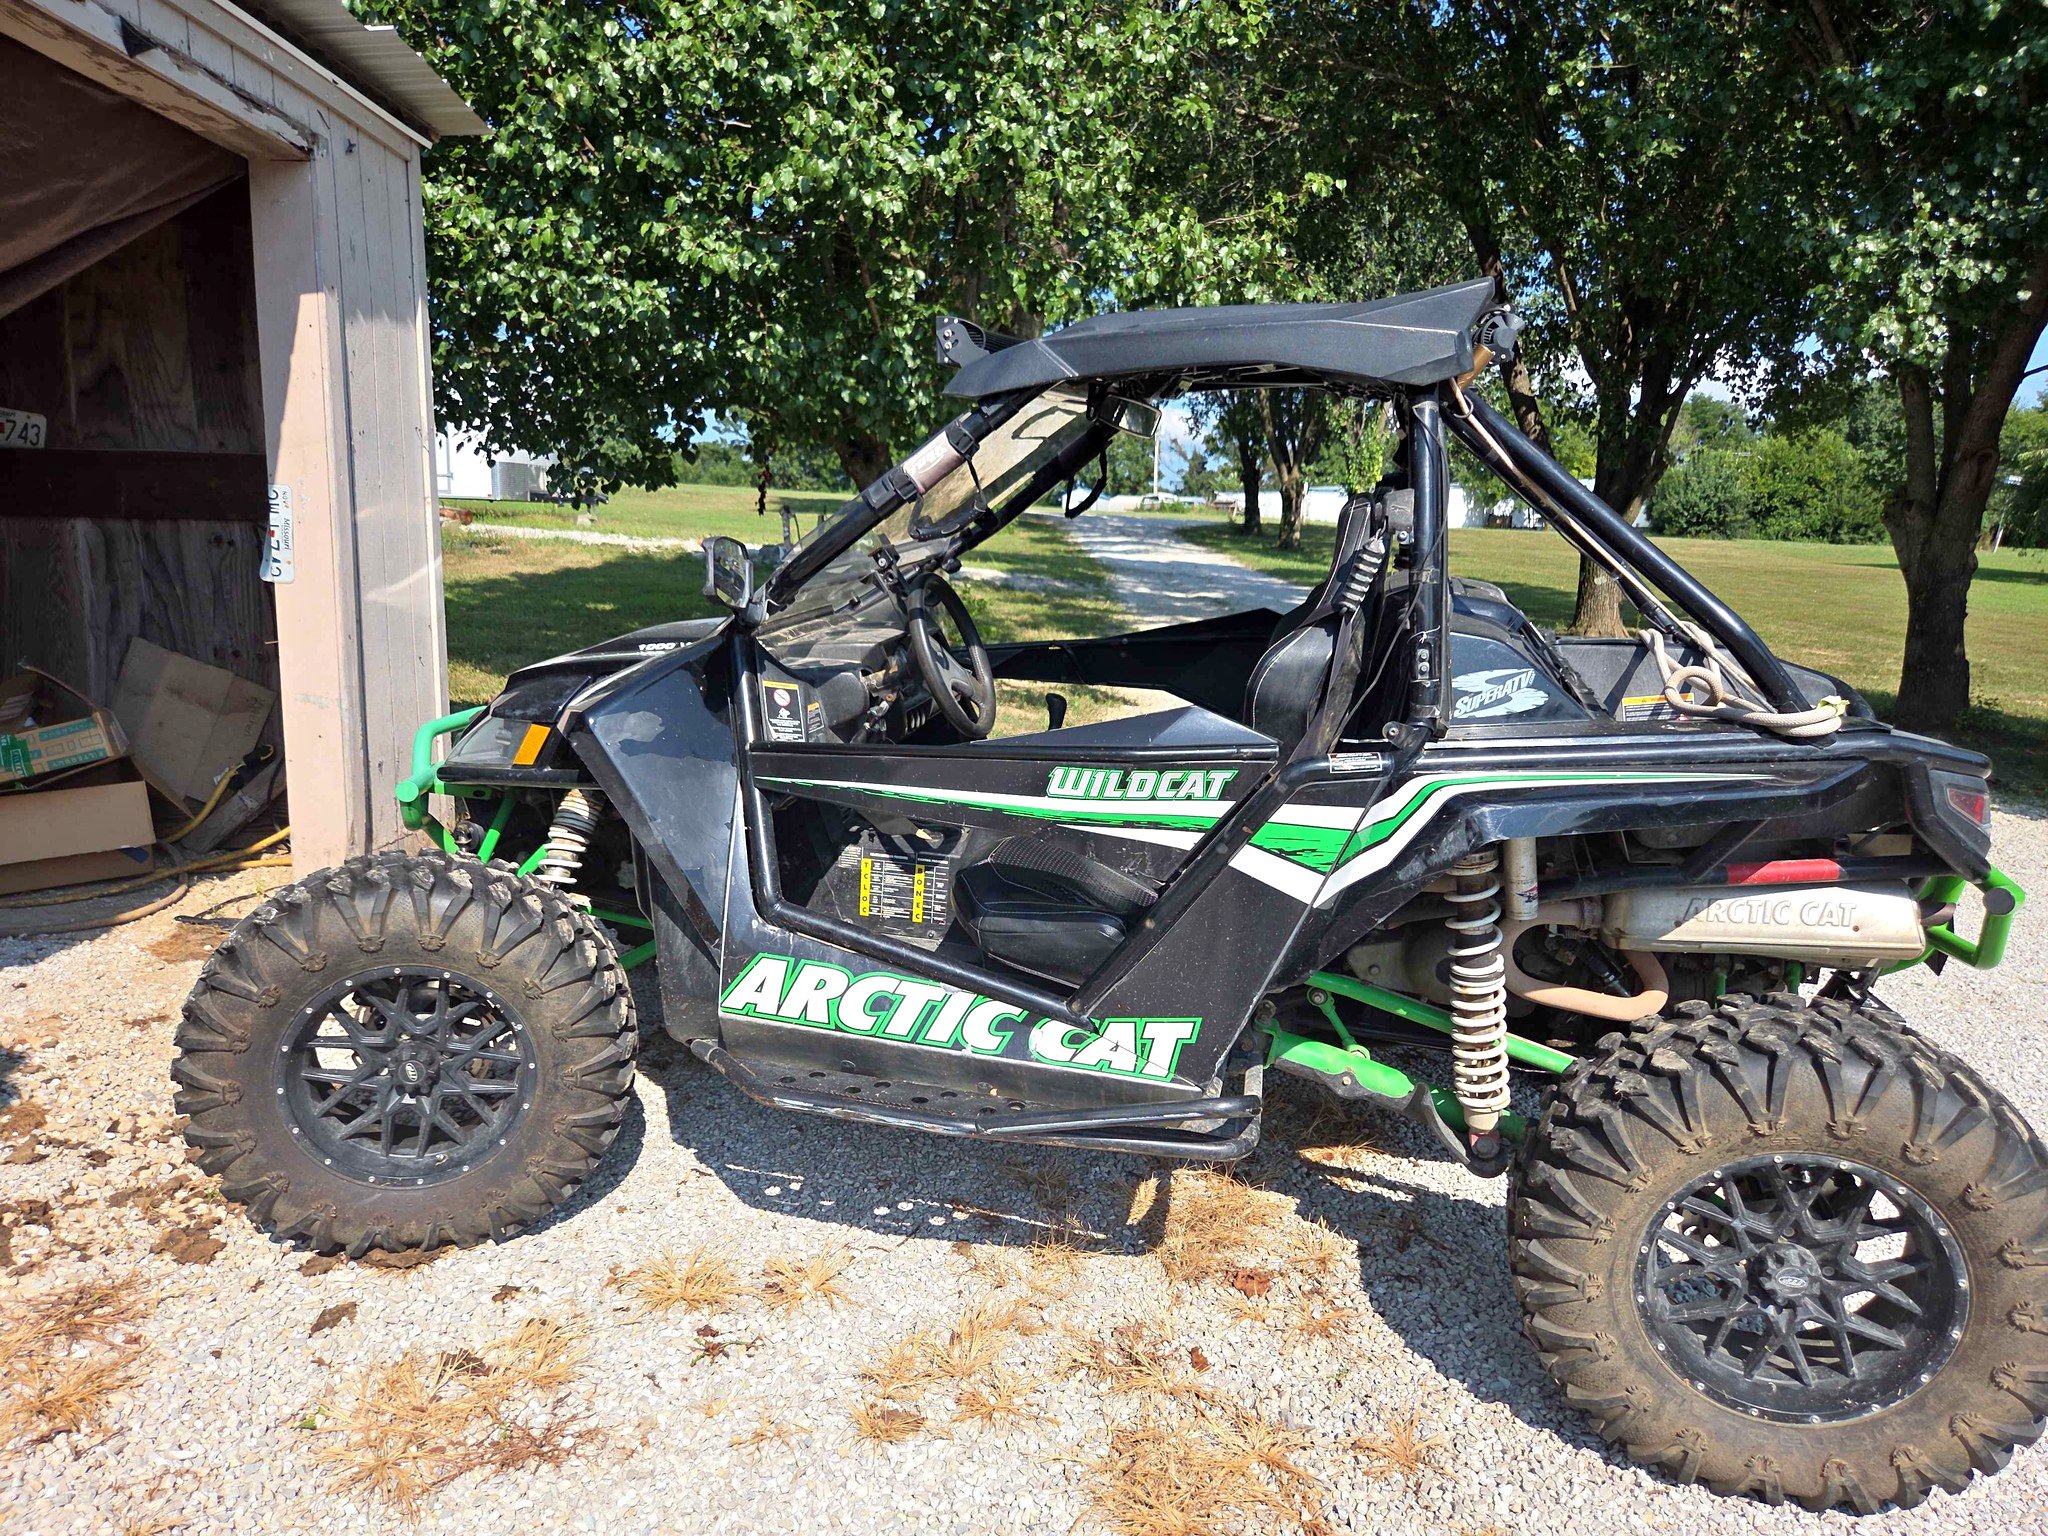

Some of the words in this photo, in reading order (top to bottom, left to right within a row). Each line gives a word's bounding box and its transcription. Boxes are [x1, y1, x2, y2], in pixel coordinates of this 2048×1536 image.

[283, 517, 292, 551] Missouri
[1046, 766, 1239, 800] WILDCAT
[1682, 897, 1791, 925] ARCTIC
[1800, 900, 1857, 927] CAT
[720, 953, 1028, 1055] ARCTIC
[1029, 1016, 1202, 1082] CAT
